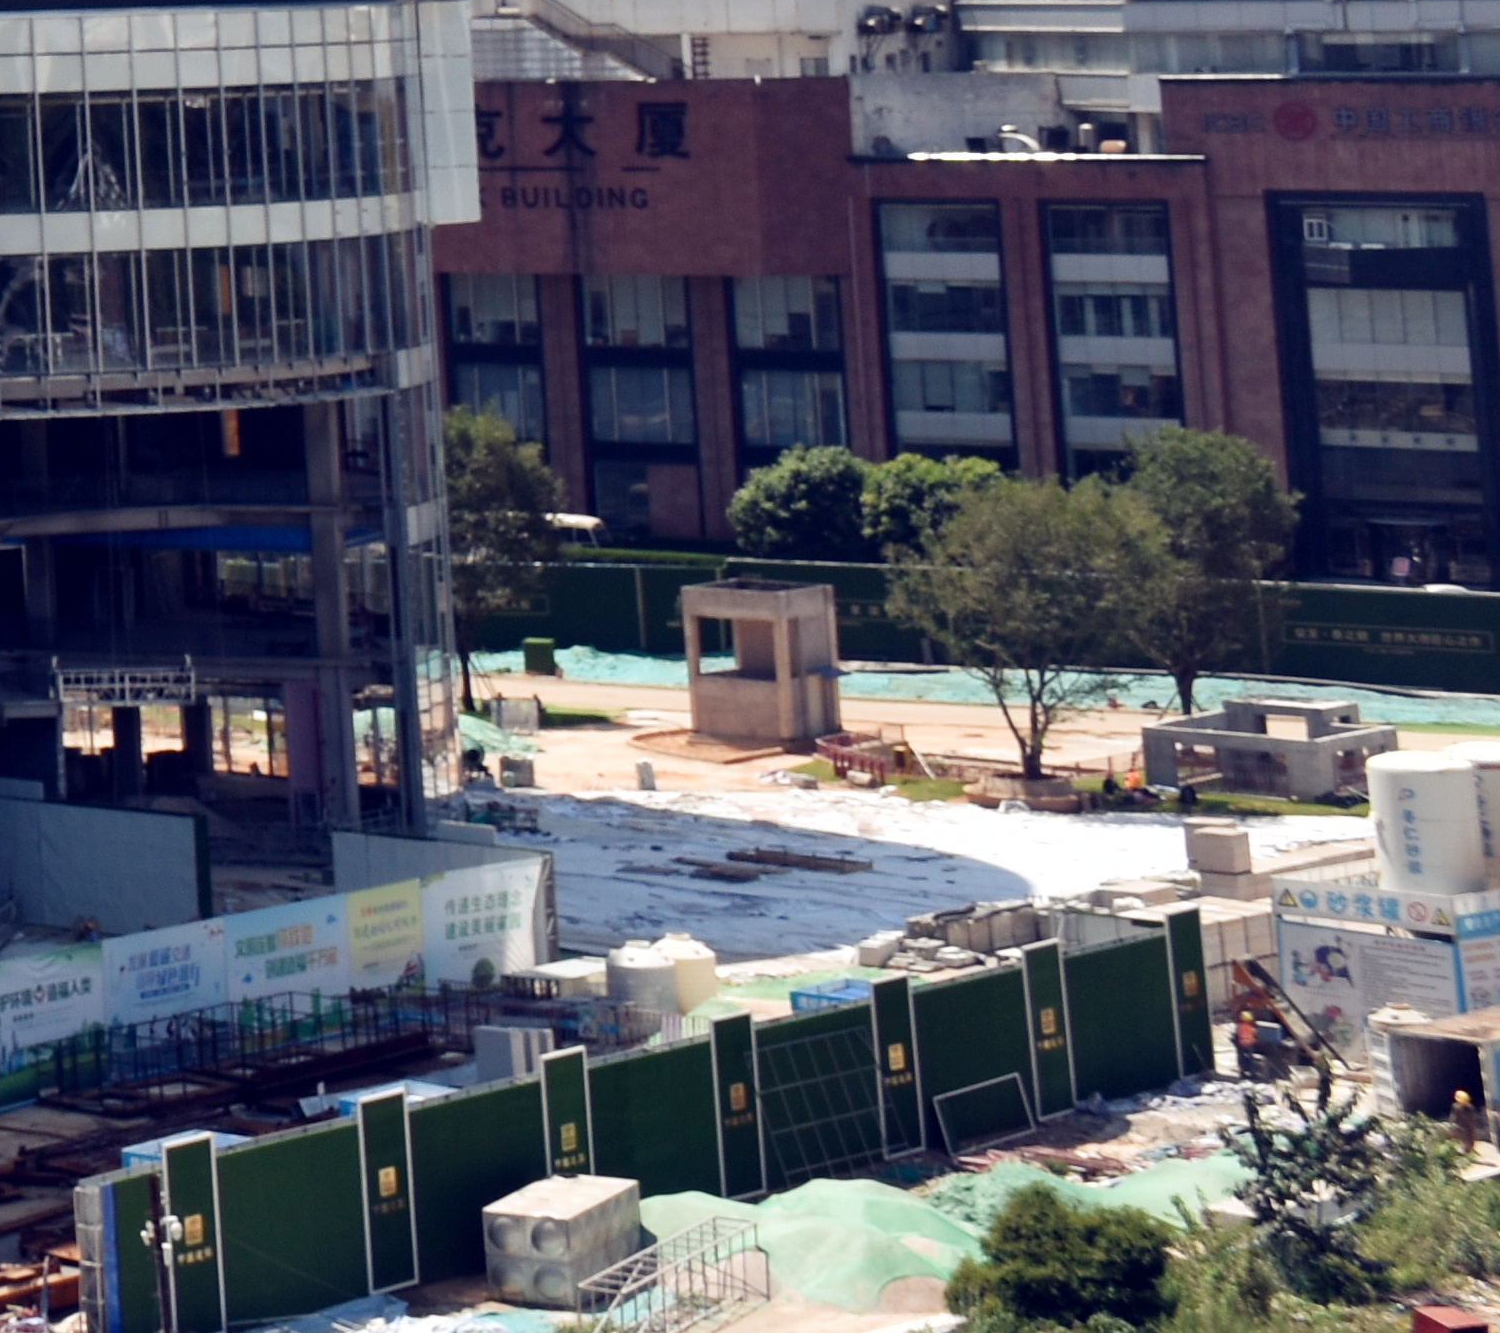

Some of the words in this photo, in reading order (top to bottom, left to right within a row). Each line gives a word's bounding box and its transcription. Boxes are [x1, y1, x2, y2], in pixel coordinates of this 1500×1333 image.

[1332, 105, 1500, 134] 中国工商银
[501, 186, 650, 210] BUILDING
[1325, 890, 1401, 922] 砂浆罐
